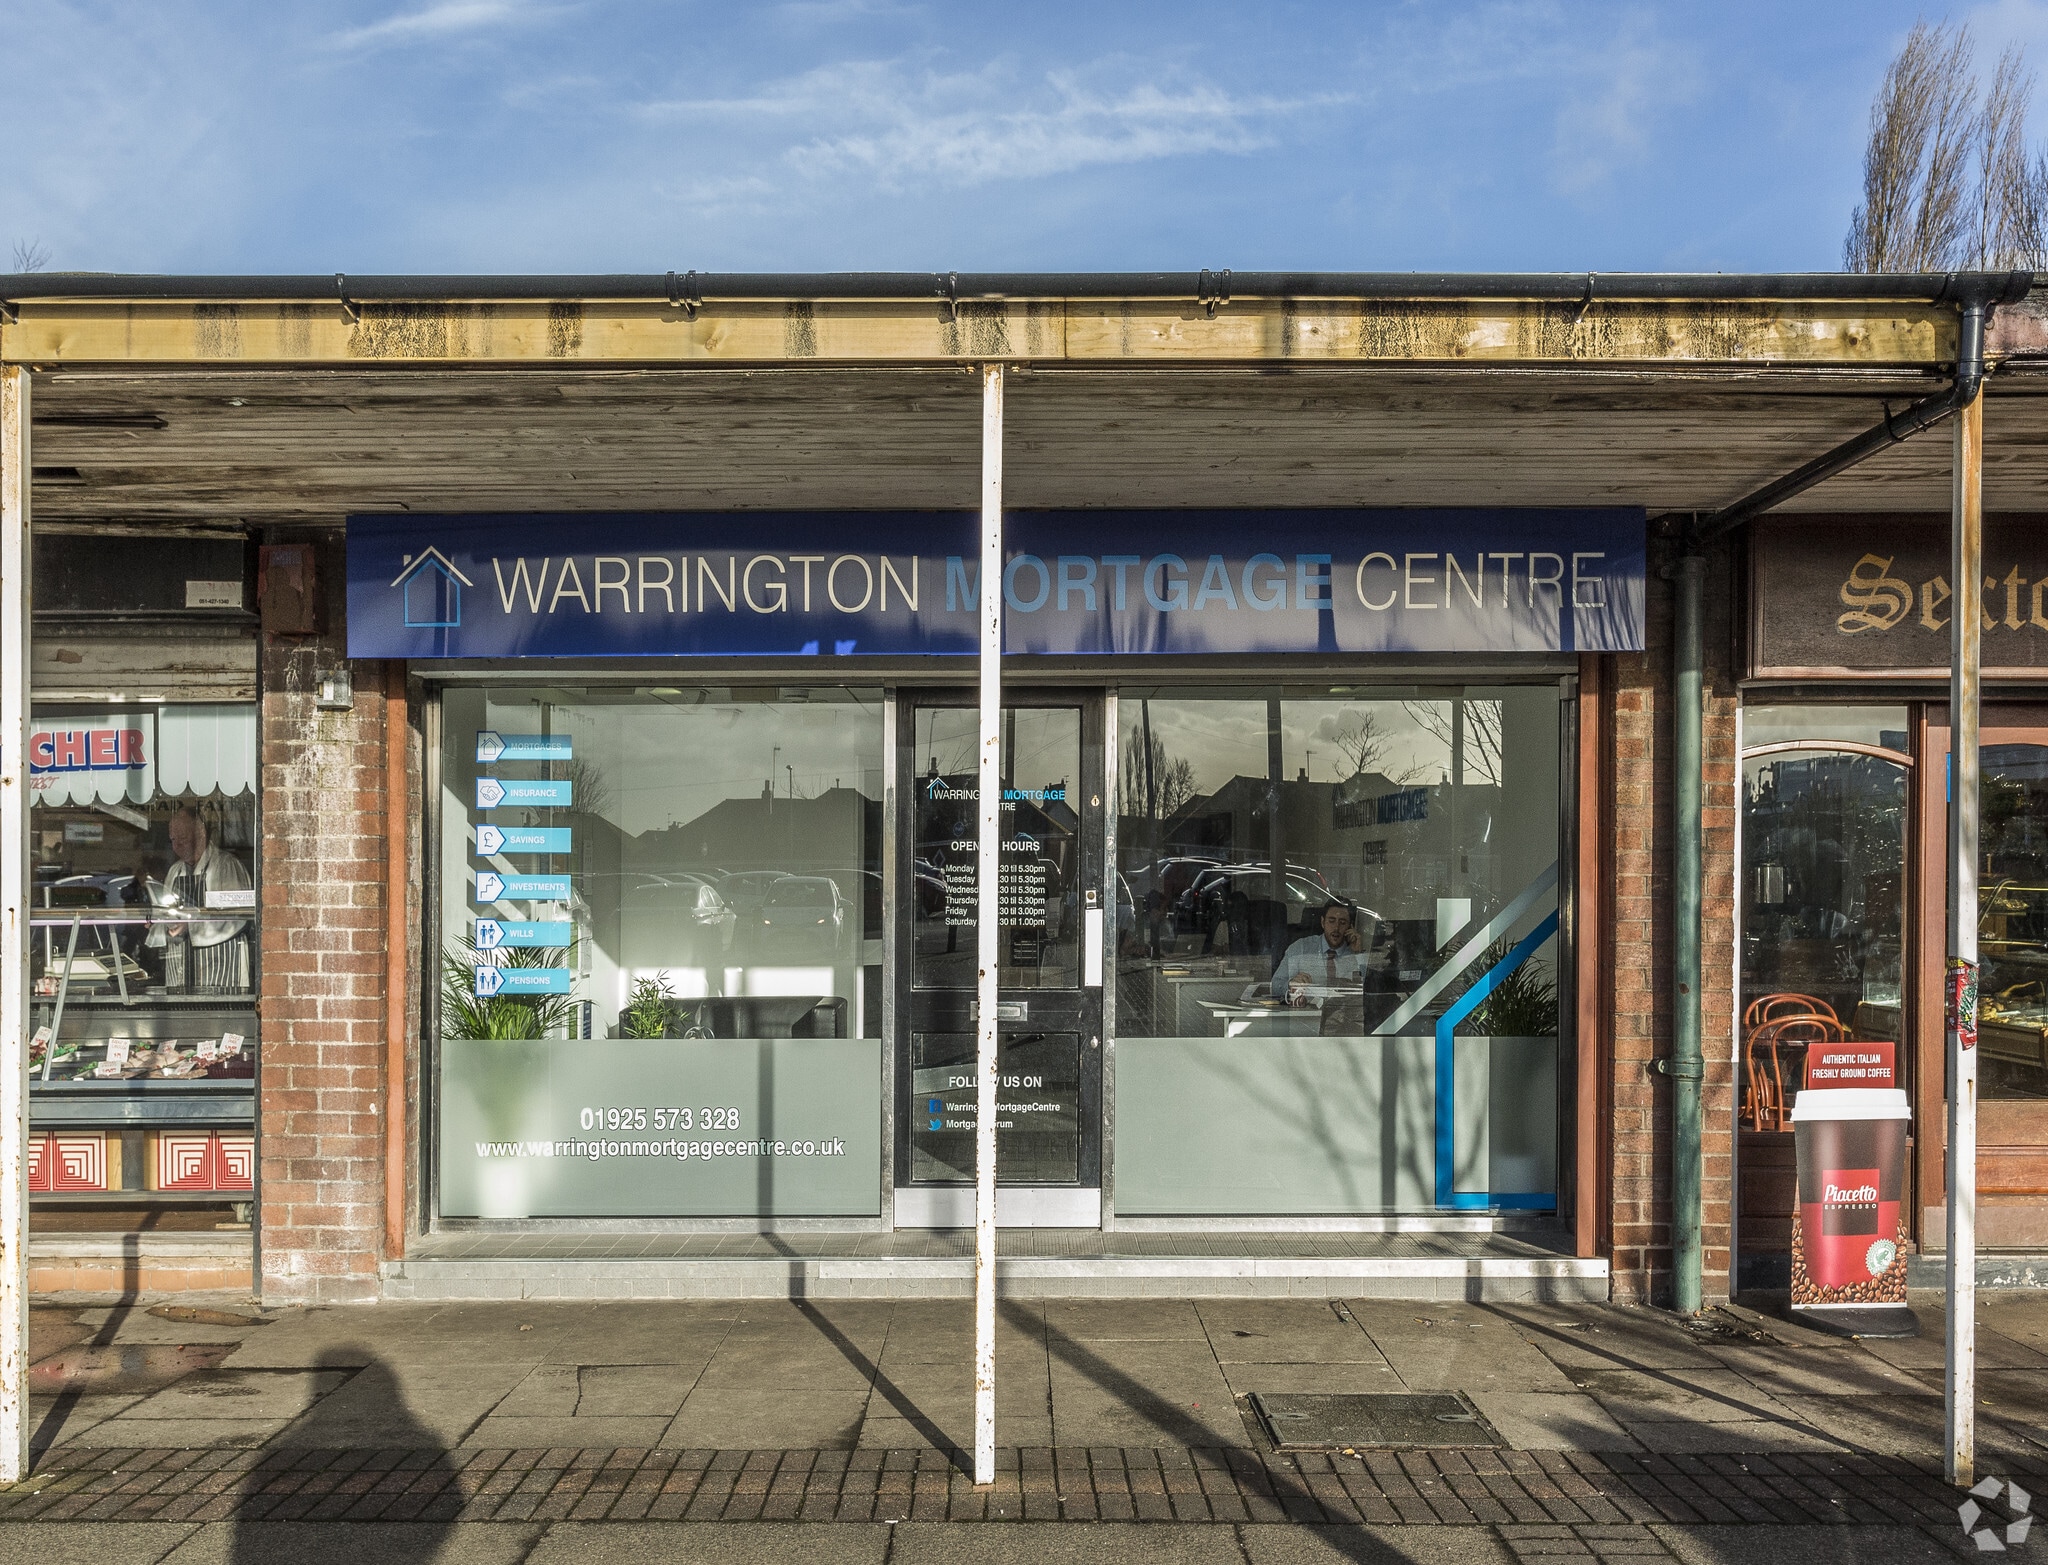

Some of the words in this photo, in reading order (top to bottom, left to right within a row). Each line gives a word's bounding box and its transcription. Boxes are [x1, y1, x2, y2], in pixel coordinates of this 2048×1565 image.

[492, 553, 918, 614] WARRINGTON
[945, 553, 1333, 613] MORTGAGE
[1355, 551, 1606, 612] CENTRE
[30, 729, 148, 772] CHER
[510, 742, 562, 751] MORTGAGES
[510, 789, 557, 797] INSURANCE
[933, 789, 1001, 800] WARRING
[1003, 789, 1066, 800] MORTGAGE
[510, 835, 546, 844] SAVINGS
[951, 841, 980, 851] OPEN
[1002, 841, 1040, 851] HOURS
[945, 865, 975, 874] Monday
[1018, 865, 1046, 874] 5.30pm
[945, 875, 976, 885] Tuesday
[1018, 875, 1046, 885] 5.30pm
[510, 882, 566, 891] INVESTMENTS
[945, 886, 979, 895] Wednesd
[1018, 886, 1046, 895] 5.30pm
[945, 896, 979, 906] Thursday
[1018, 896, 1046, 906] 5.30pm
[945, 907, 968, 917] Friday
[1018, 907, 1046, 916] 3.00pm
[945, 918, 977, 927] Saturday
[1018, 918, 1046, 927] 1.00pm
[509, 929, 534, 938] WILLS
[509, 976, 551, 985] PENSIONS
[1822, 1054, 1856, 1065] AUTHENTIC
[1857, 1053, 1881, 1064] ITALIAN
[1812, 1068, 1839, 1079] FRESHLY
[1840, 1068, 1866, 1078] GROUND
[1867, 1067, 1891, 1078] COFFEE
[1003, 1076, 1020, 1088] US
[1023, 1076, 1042, 1088] ON
[580, 1106, 648, 1131] 01925
[653, 1106, 694, 1131] 573
[698, 1106, 741, 1131] 328
[475, 1136, 847, 1162] www.warringtonmortgagecentre.co.uk
[1824, 1184, 1877, 1202] Piacetto
